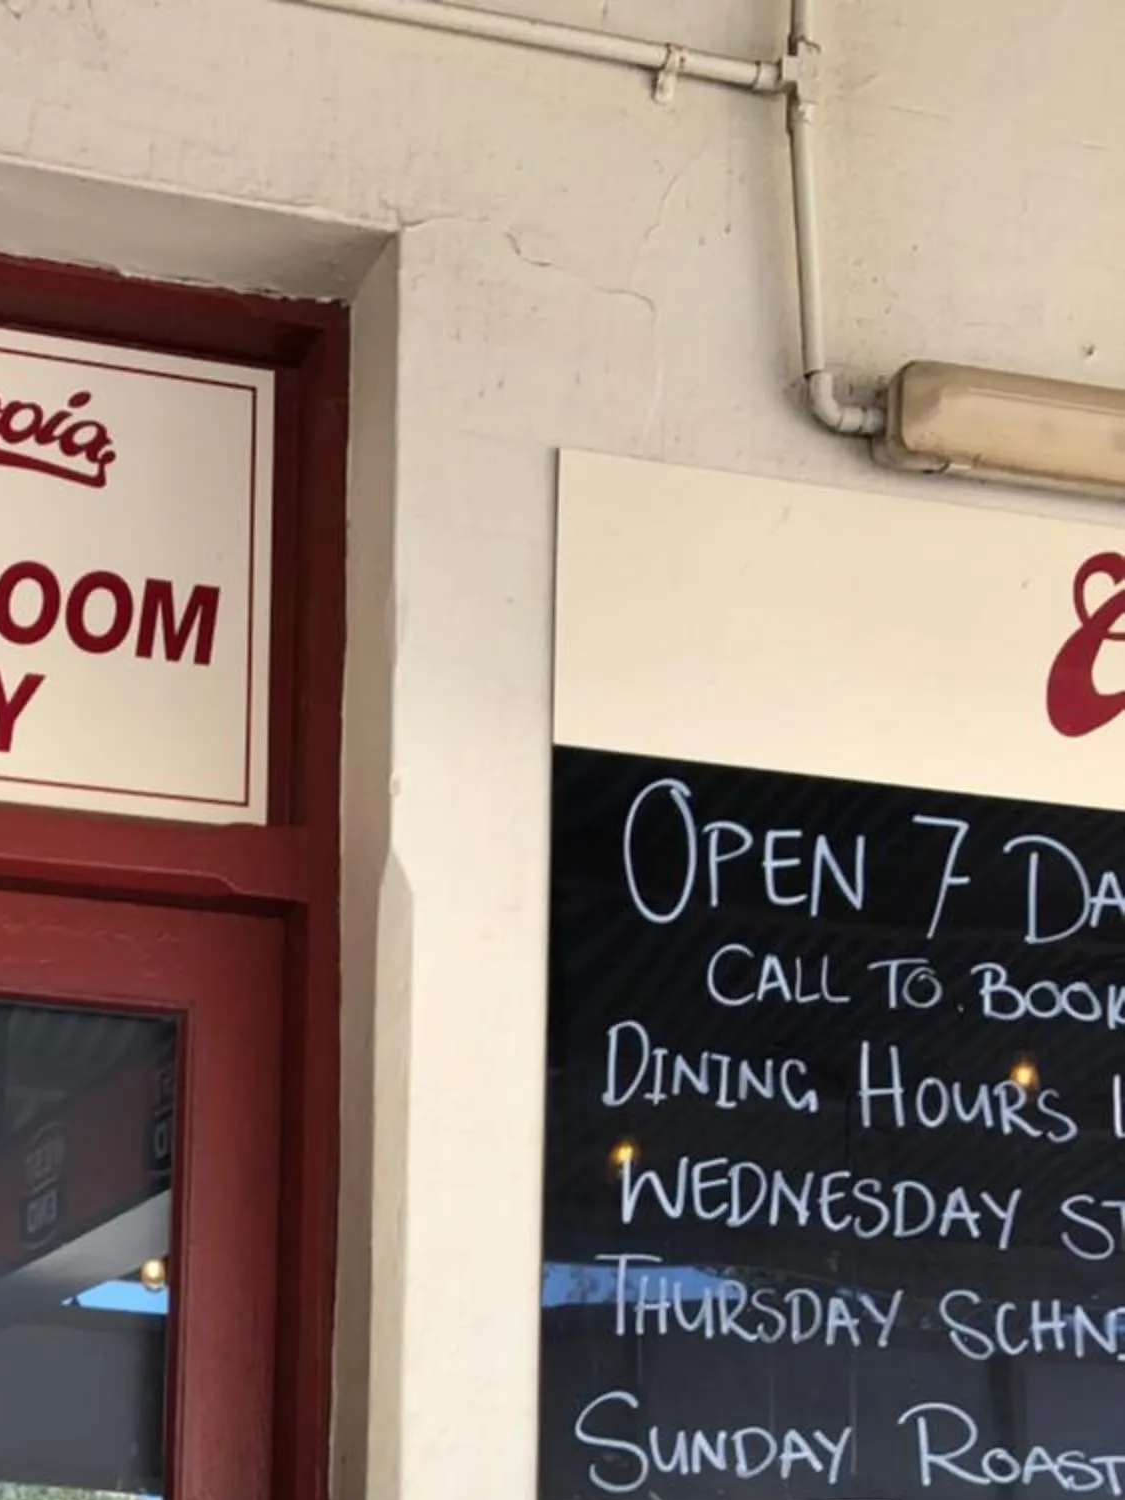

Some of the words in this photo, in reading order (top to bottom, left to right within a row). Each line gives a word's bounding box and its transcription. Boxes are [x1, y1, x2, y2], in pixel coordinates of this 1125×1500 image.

[624, 778, 865, 924] OPEN
[912, 815, 971, 939] 7
[706, 943, 851, 1006] CALL
[867, 959, 943, 1009] TO
[602, 1020, 819, 1113] DINING
[858, 1040, 1079, 1143] HOURS
[619, 1148, 1022, 1250] WEDNESDAY
[595, 1253, 904, 1349] THURSDAY
[939, 1289, 1125, 1361] SCHN
[575, 1390, 854, 1492] SUNDAY
